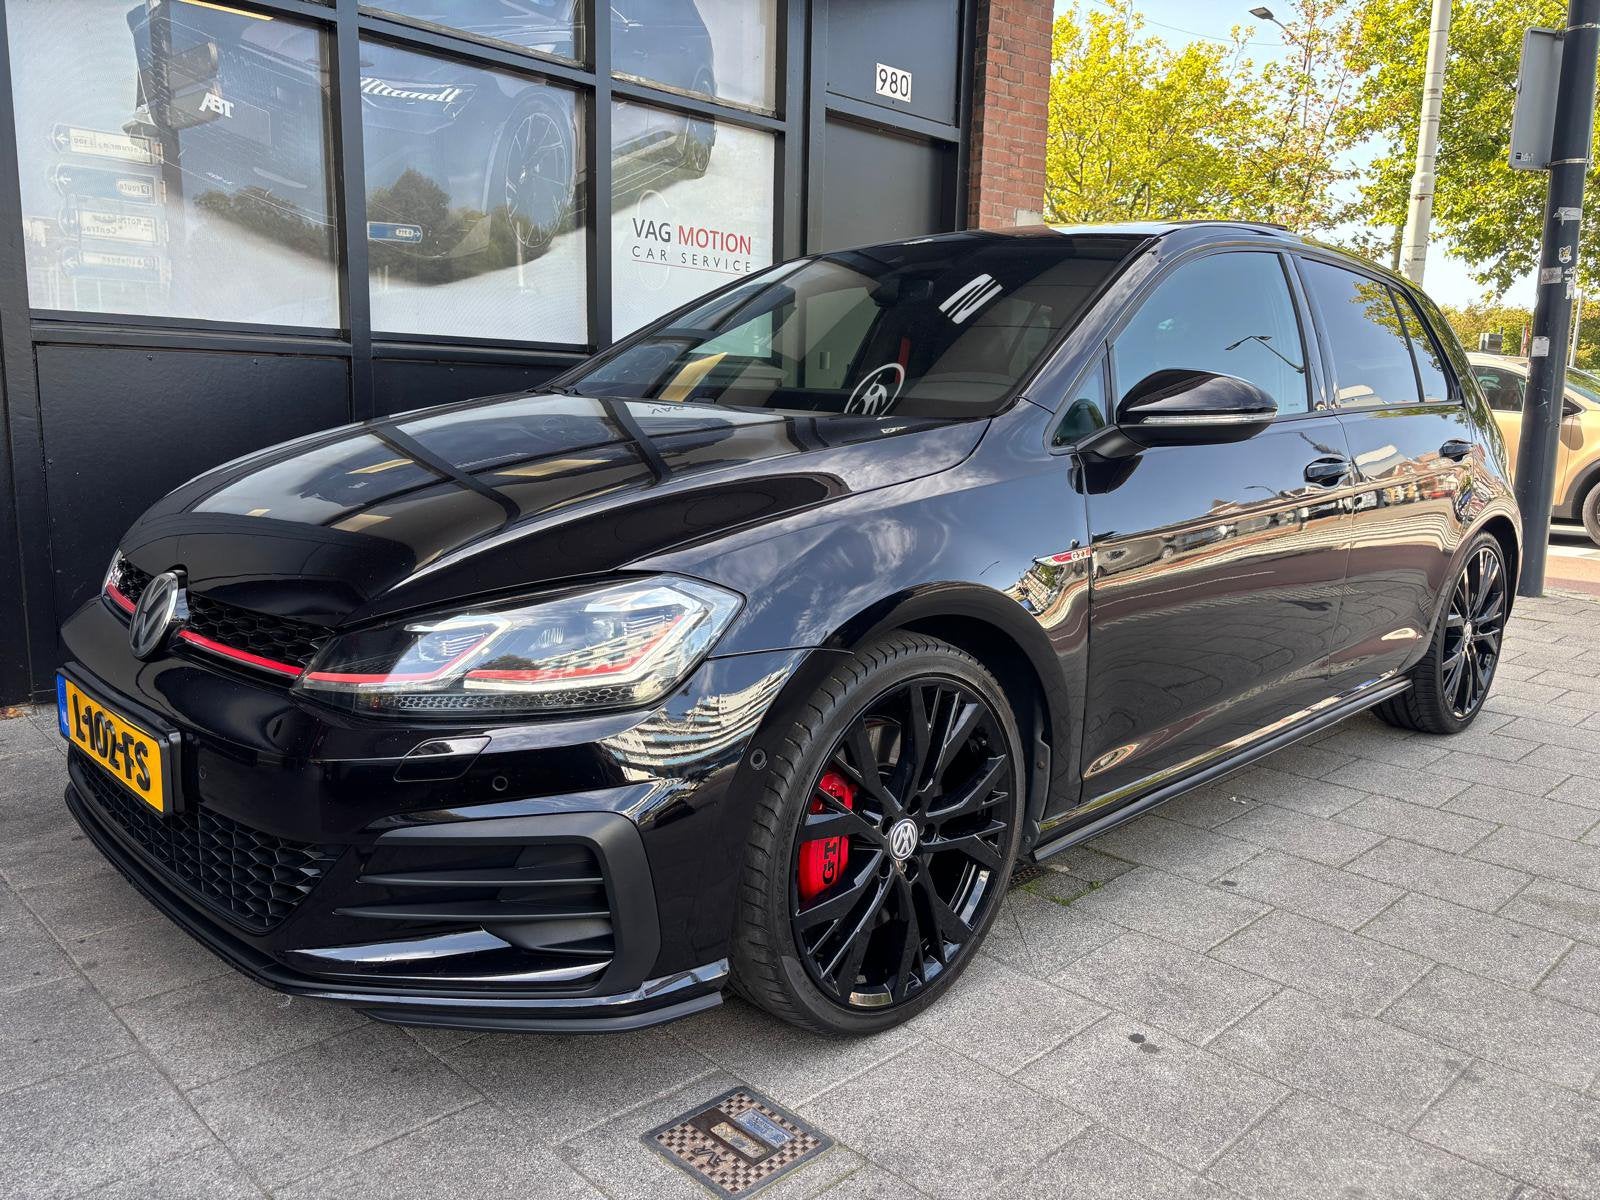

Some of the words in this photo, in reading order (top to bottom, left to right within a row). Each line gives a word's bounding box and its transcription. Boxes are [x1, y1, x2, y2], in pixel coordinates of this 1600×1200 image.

[878, 67, 909, 98] 980
[199, 91, 234, 118] ABT
[632, 217, 671, 242] VAG
[678, 224, 751, 255] MOTION
[632, 245, 667, 261] CAR
[681, 252, 751, 273] SERVICE
